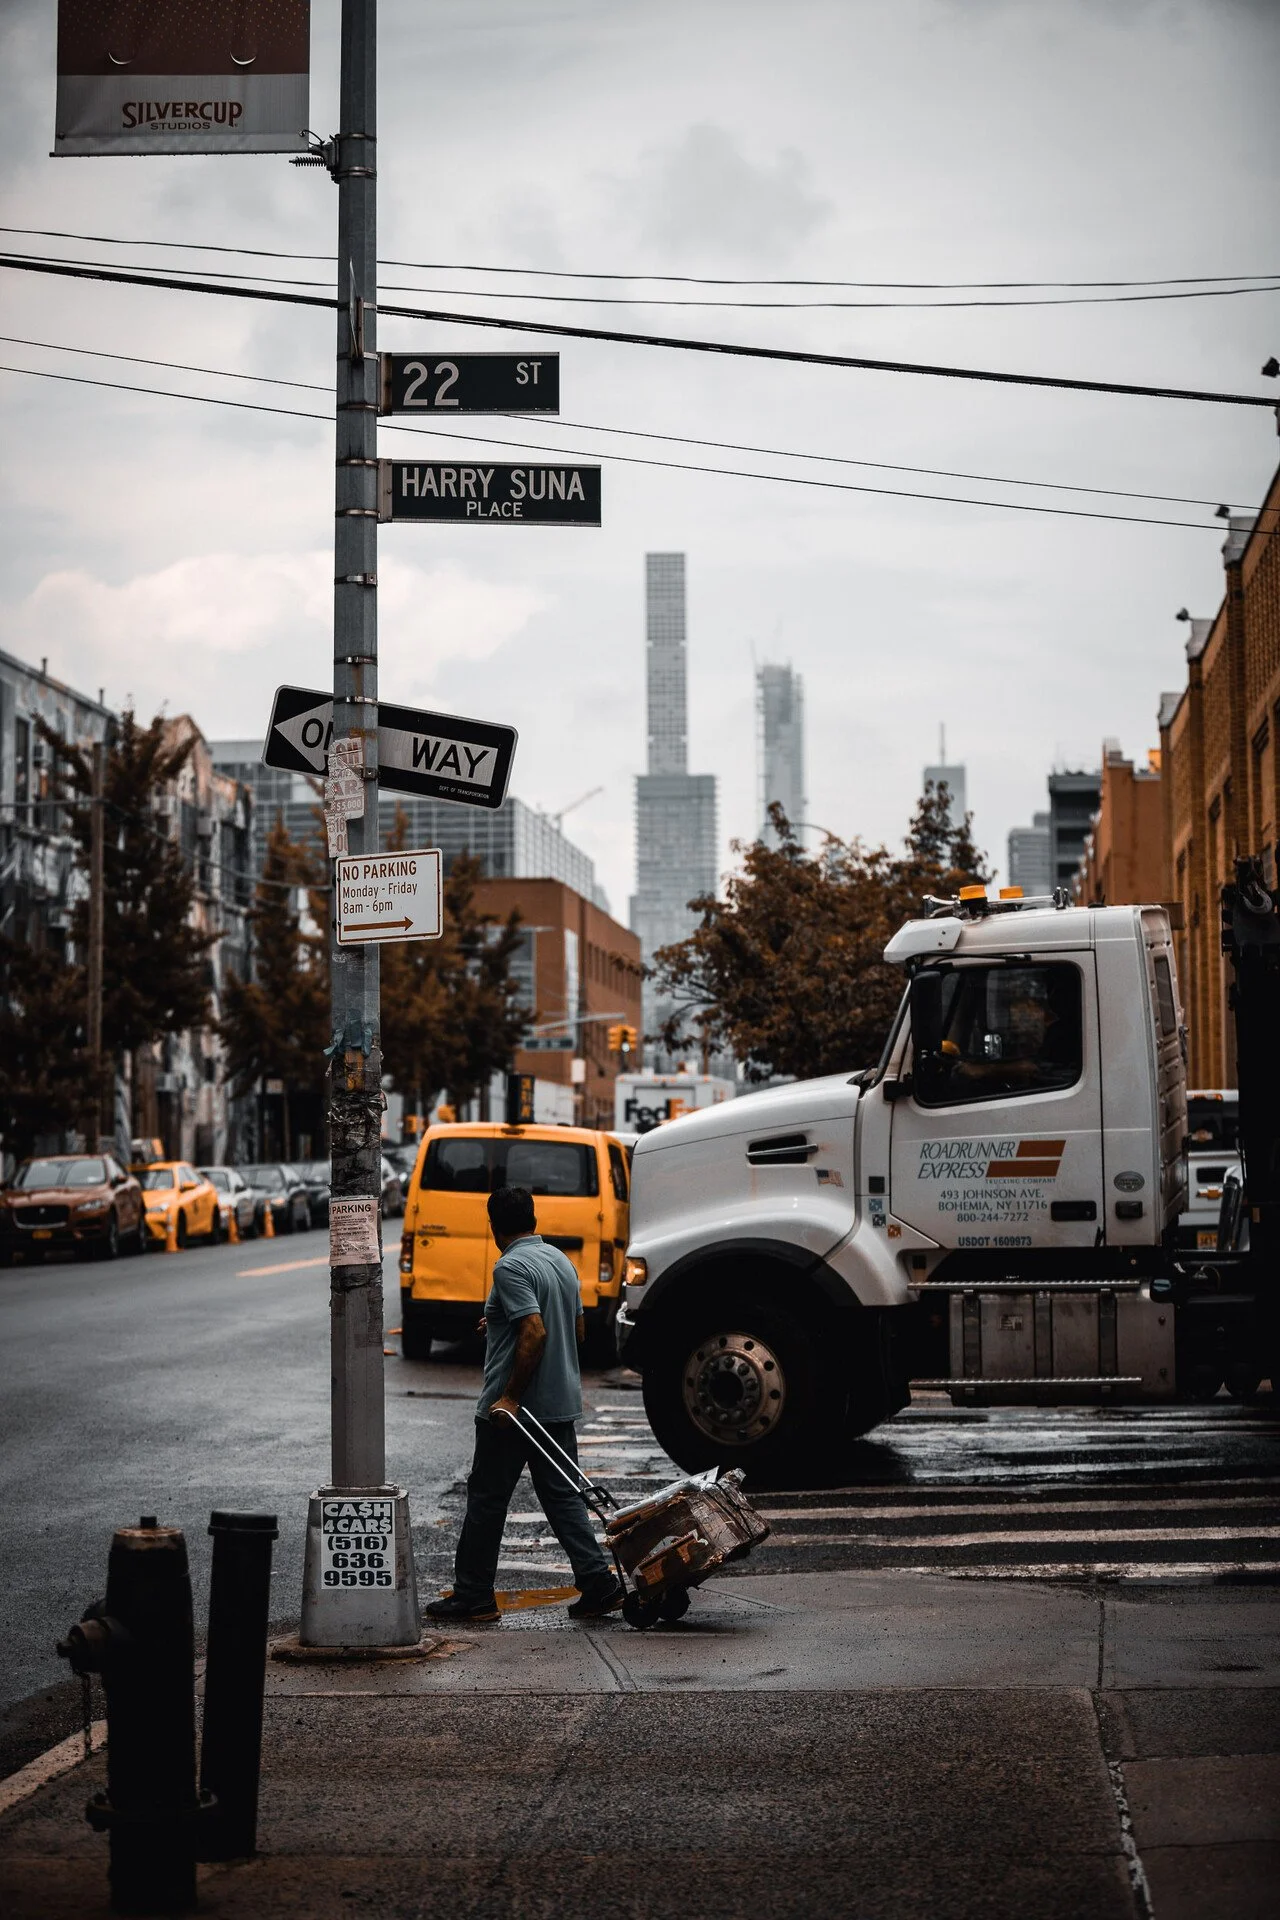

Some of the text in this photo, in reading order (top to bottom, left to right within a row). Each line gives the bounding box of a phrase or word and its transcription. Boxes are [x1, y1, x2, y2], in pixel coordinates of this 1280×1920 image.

[122, 101, 243, 129] SILVERCUP
[150, 121, 211, 131] STUDIOS
[403, 361, 542, 406] 22 ST
[402, 467, 585, 501] HARRY SUNA
[466, 501, 523, 518] PLACE
[411, 736, 490, 779] WAY
[342, 860, 417, 881] NO PARKING
[342, 885, 379, 898] Monday
[388, 882, 418, 896] Friday
[343, 902, 364, 915] 8am
[372, 900, 394, 914] 6pm
[624, 1097, 703, 1123] FedE
[919, 1140, 1016, 1160] ROADRUNNER
[917, 1161, 987, 1180] EXPRESS
[940, 1188, 1045, 1201] 493 JOHNSON AVE.
[332, 1204, 371, 1214] PARKING
[938, 1200, 1048, 1212] BOHEMIA, NY 11716
[957, 1212, 1029, 1223] 800-244-7272
[958, 1236, 991, 1247] USDOT
[324, 1519, 335, 1533] 4
[328, 1536, 388, 1551] (516)
[332, 1552, 384, 1569] 636
[324, 1570, 392, 1587] 9595
